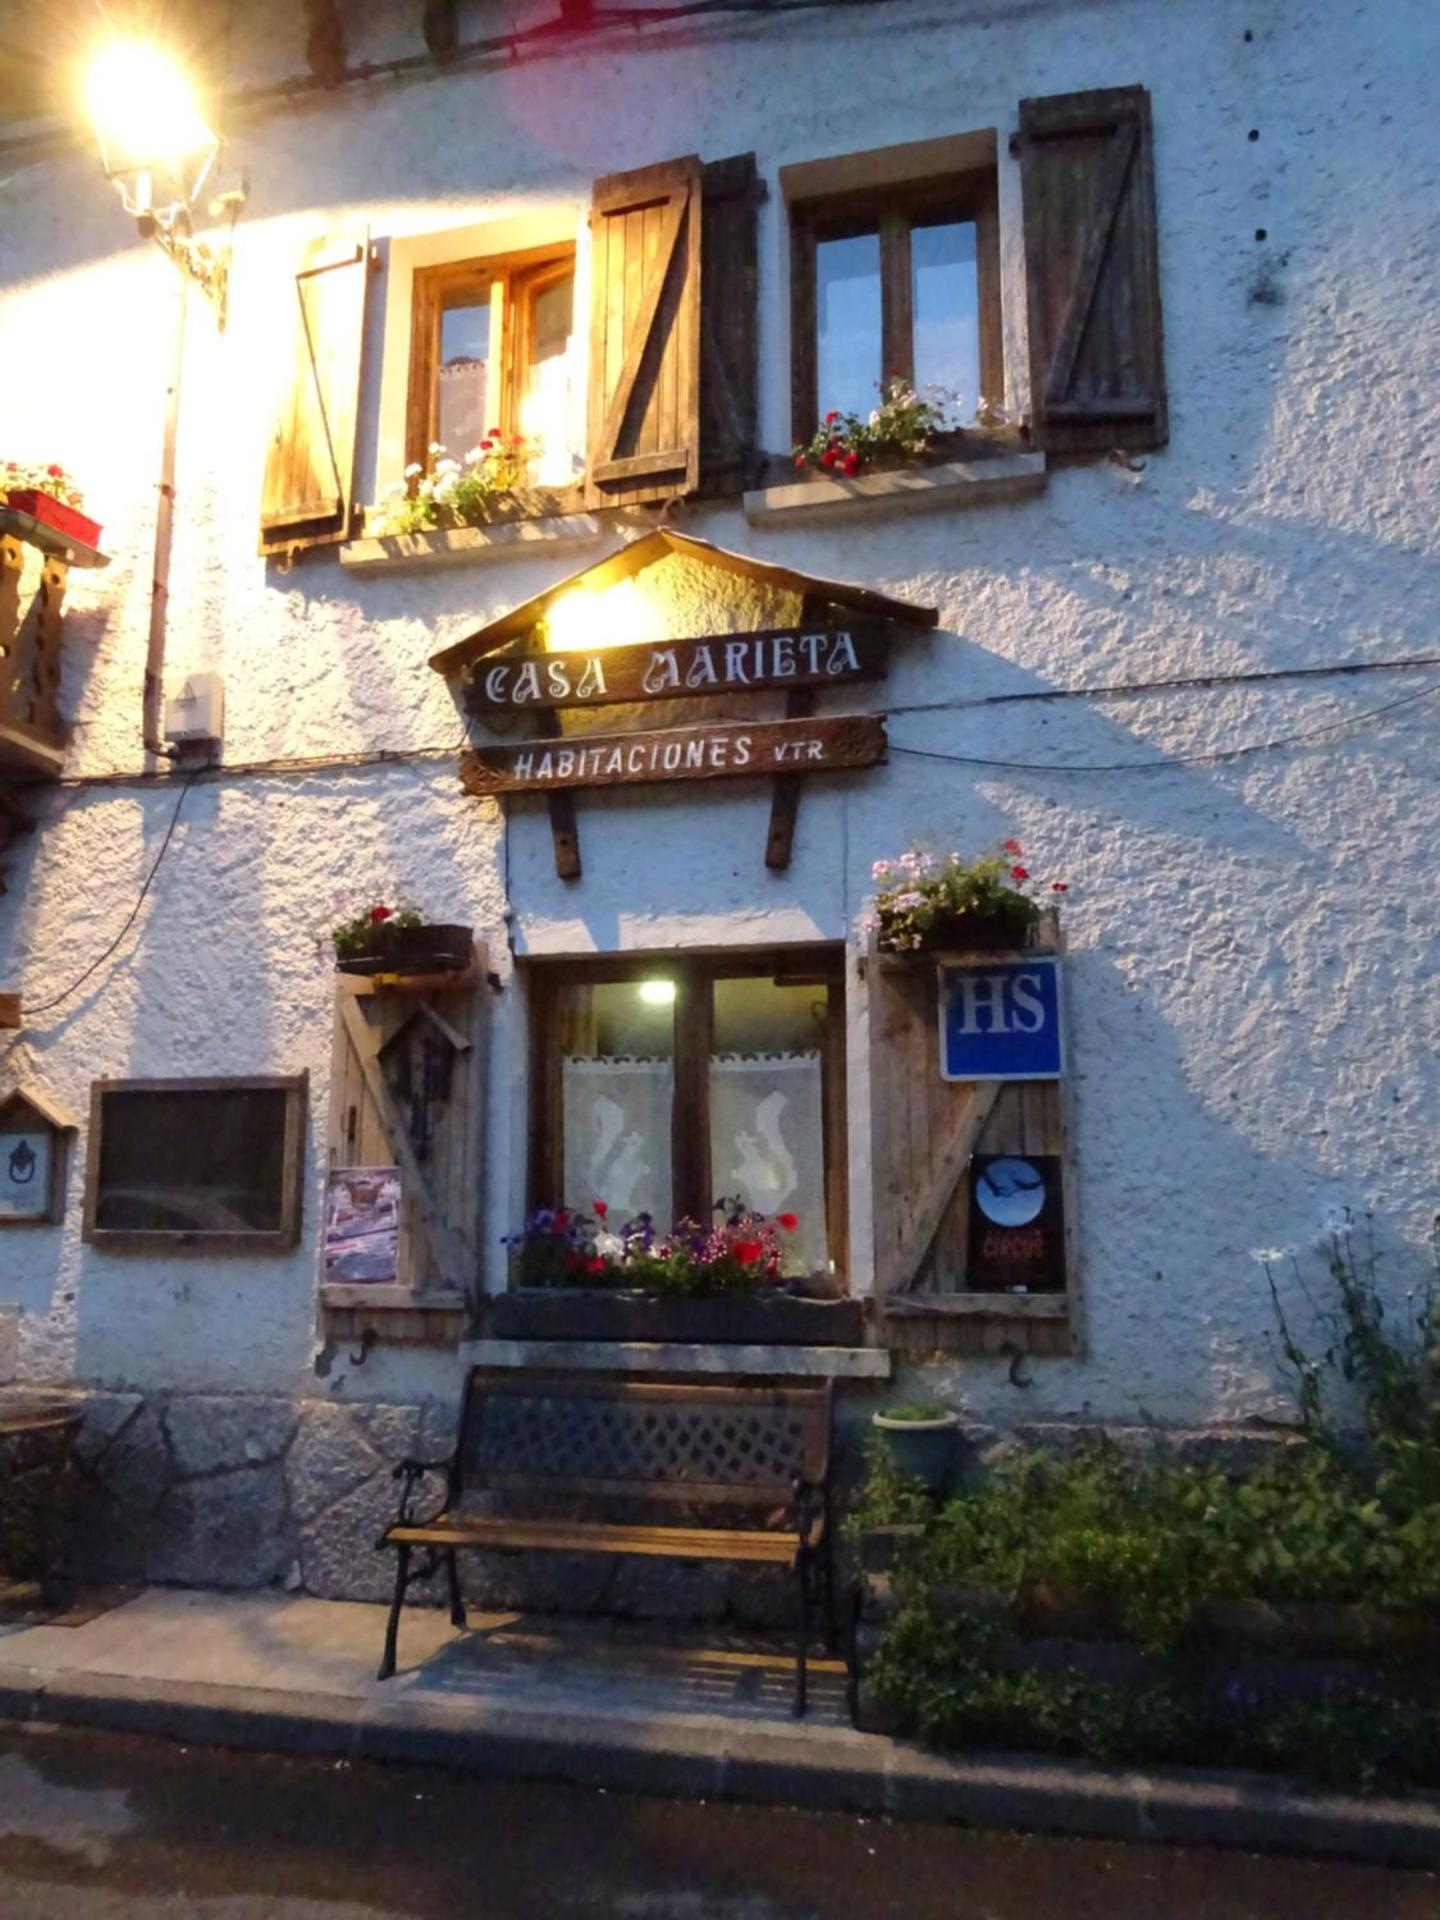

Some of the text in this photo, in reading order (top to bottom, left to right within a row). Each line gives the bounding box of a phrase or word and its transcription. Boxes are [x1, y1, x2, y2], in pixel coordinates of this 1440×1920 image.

[485, 631, 861, 703] CASA MARIETA
[514, 737, 823, 780] HABITACIONES VTR
[957, 973, 1046, 1035] HS
